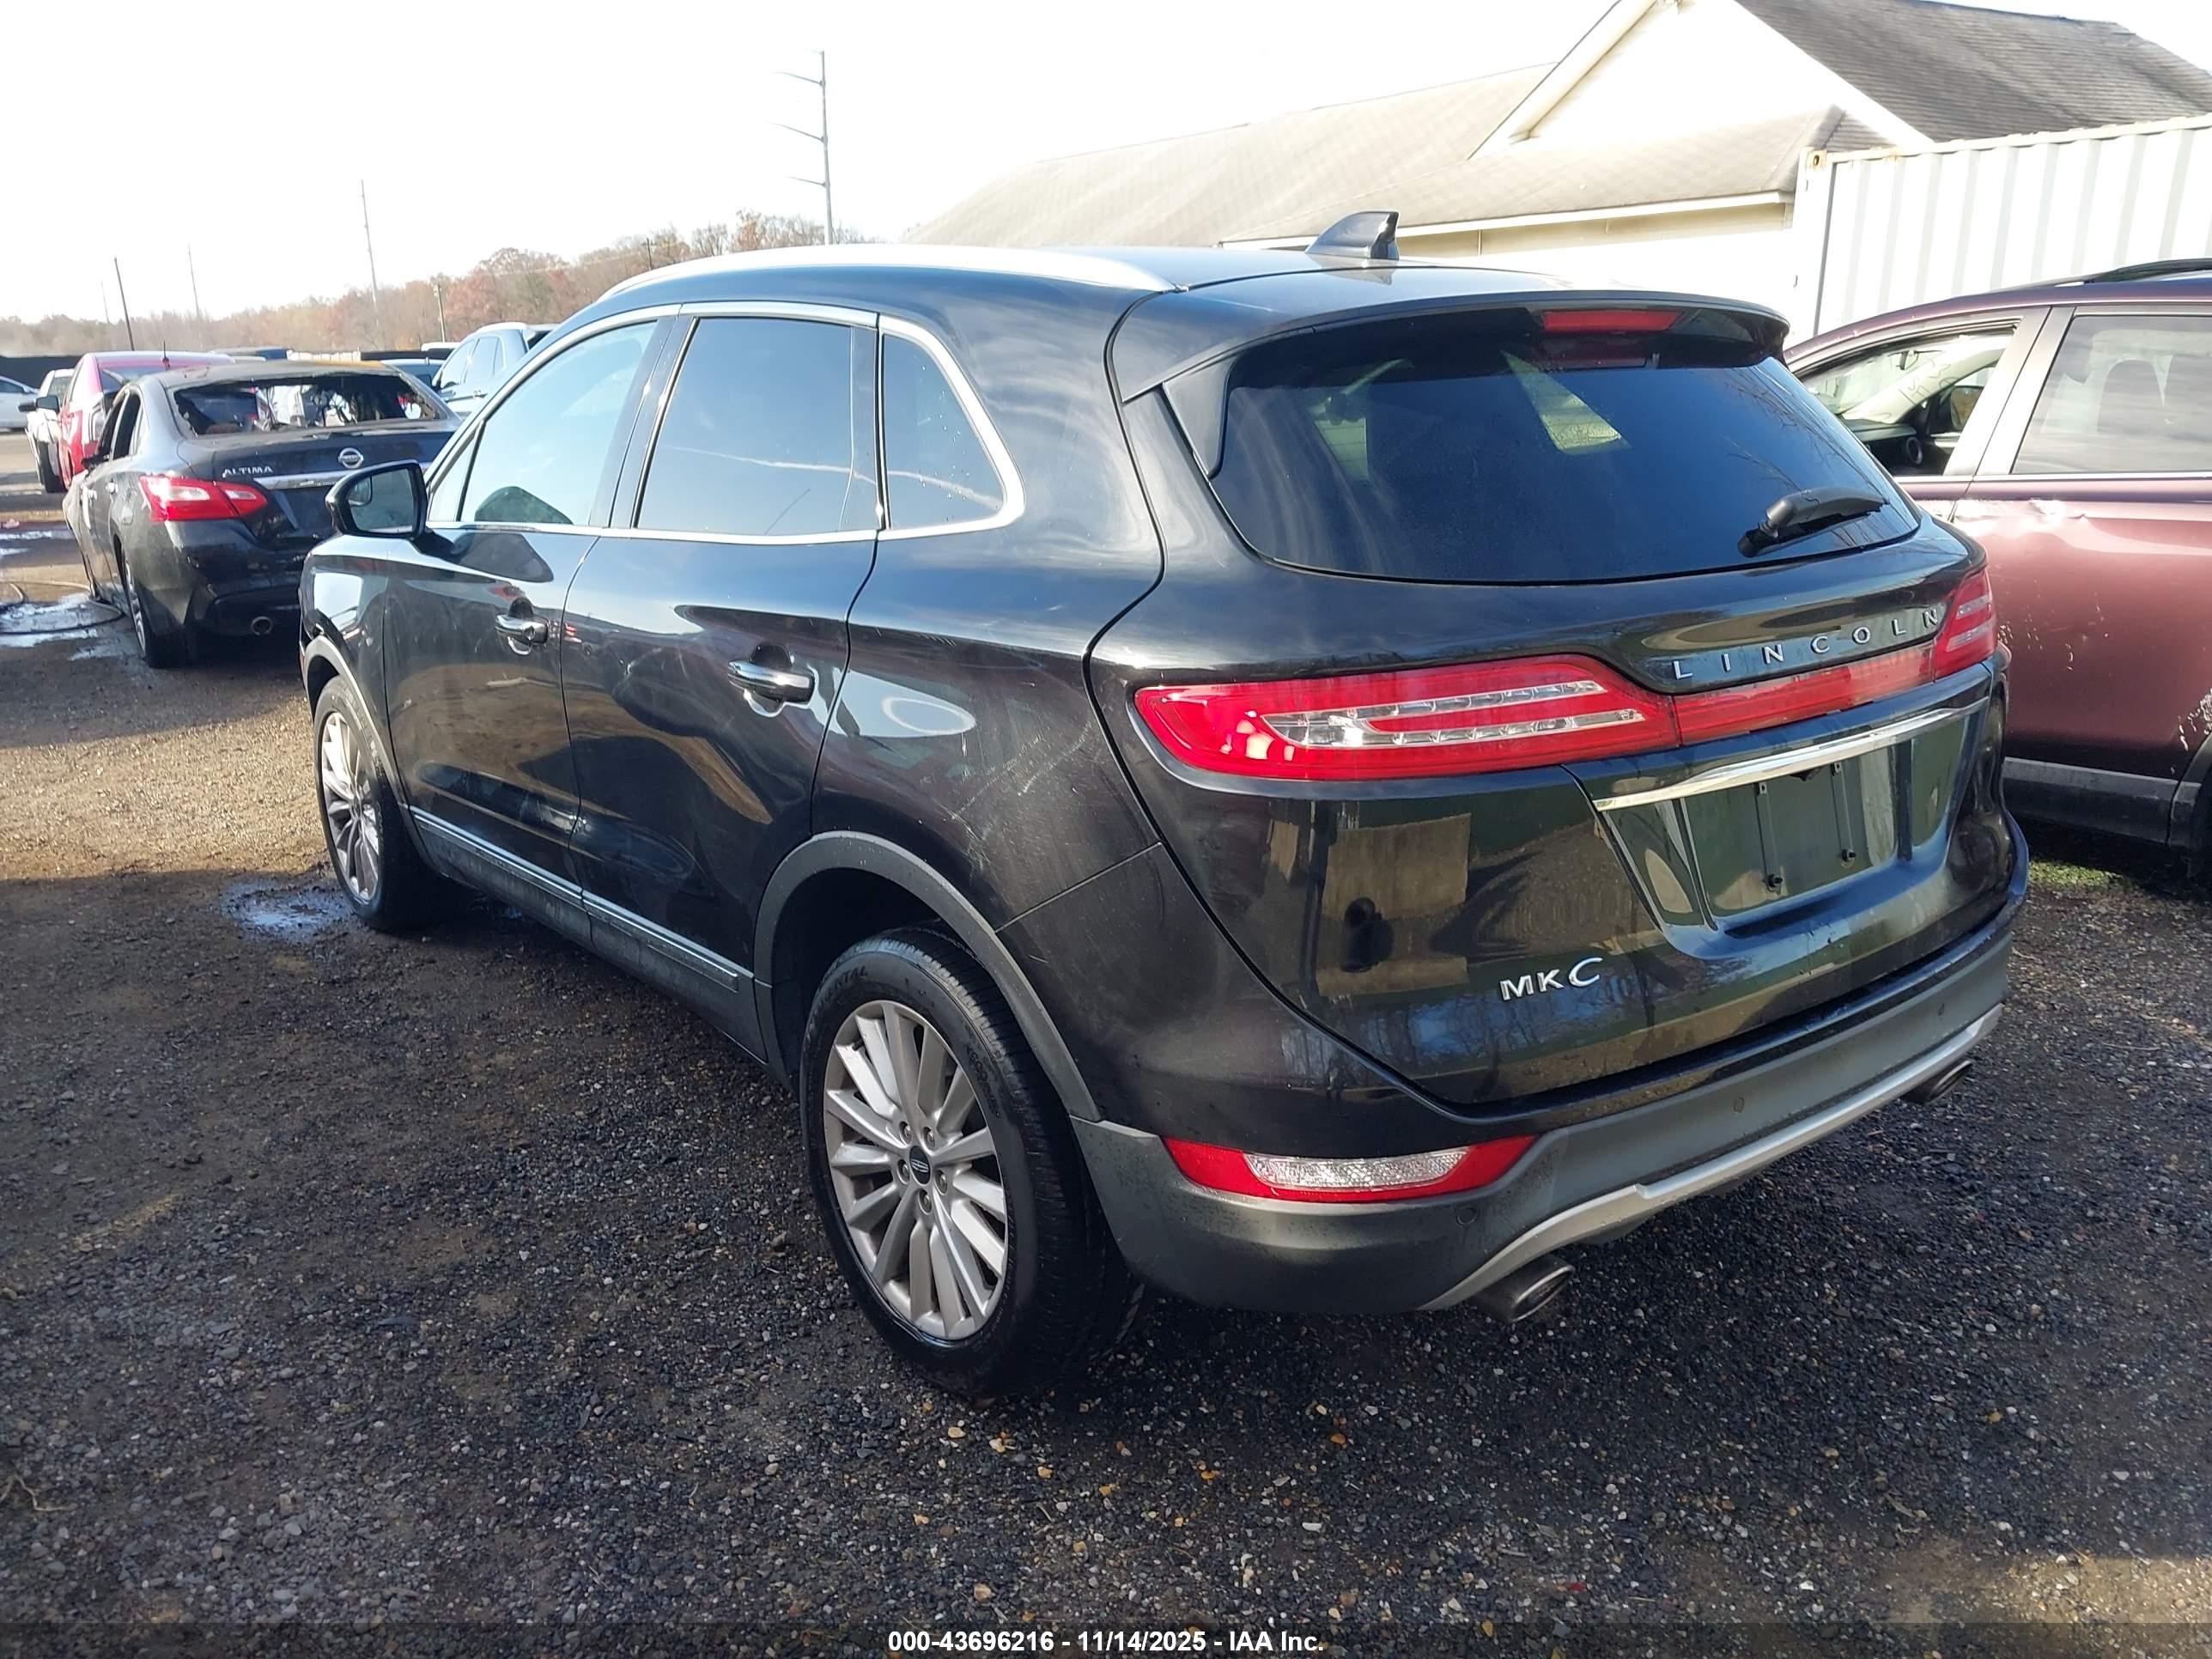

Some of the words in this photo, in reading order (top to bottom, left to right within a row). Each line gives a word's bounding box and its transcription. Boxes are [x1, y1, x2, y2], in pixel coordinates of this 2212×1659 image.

[222, 465, 274, 478] ALTIMA
[1674, 608, 1939, 680] LINCOLN
[1499, 957, 1603, 1001] MKC
